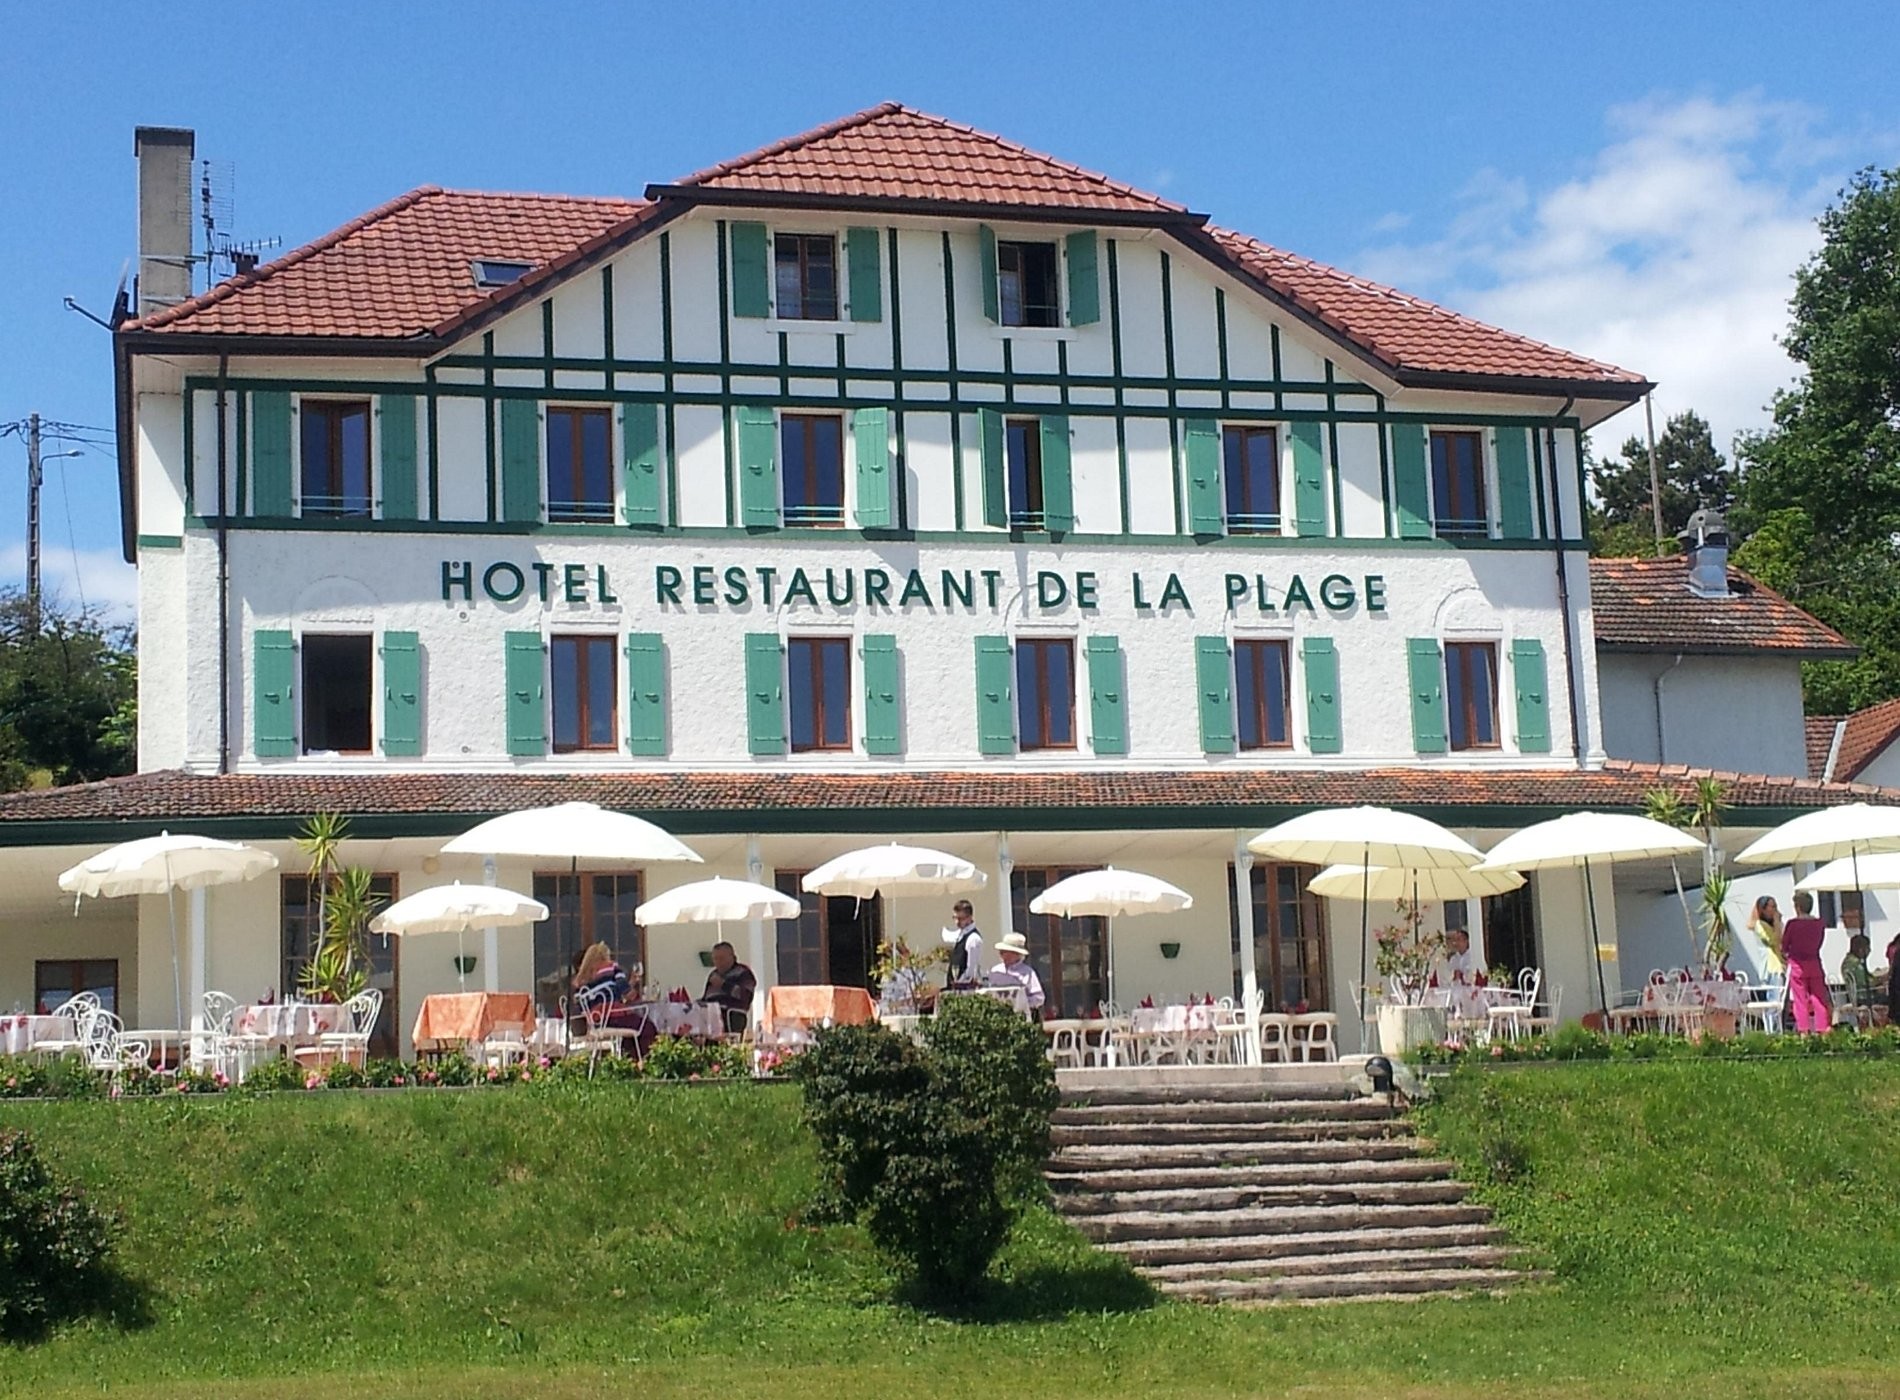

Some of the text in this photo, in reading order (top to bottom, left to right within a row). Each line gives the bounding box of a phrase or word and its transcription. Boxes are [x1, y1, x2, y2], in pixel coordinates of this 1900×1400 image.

[441, 561, 1386, 611] HOTEL RESTAURANT DE LA PLAGE
